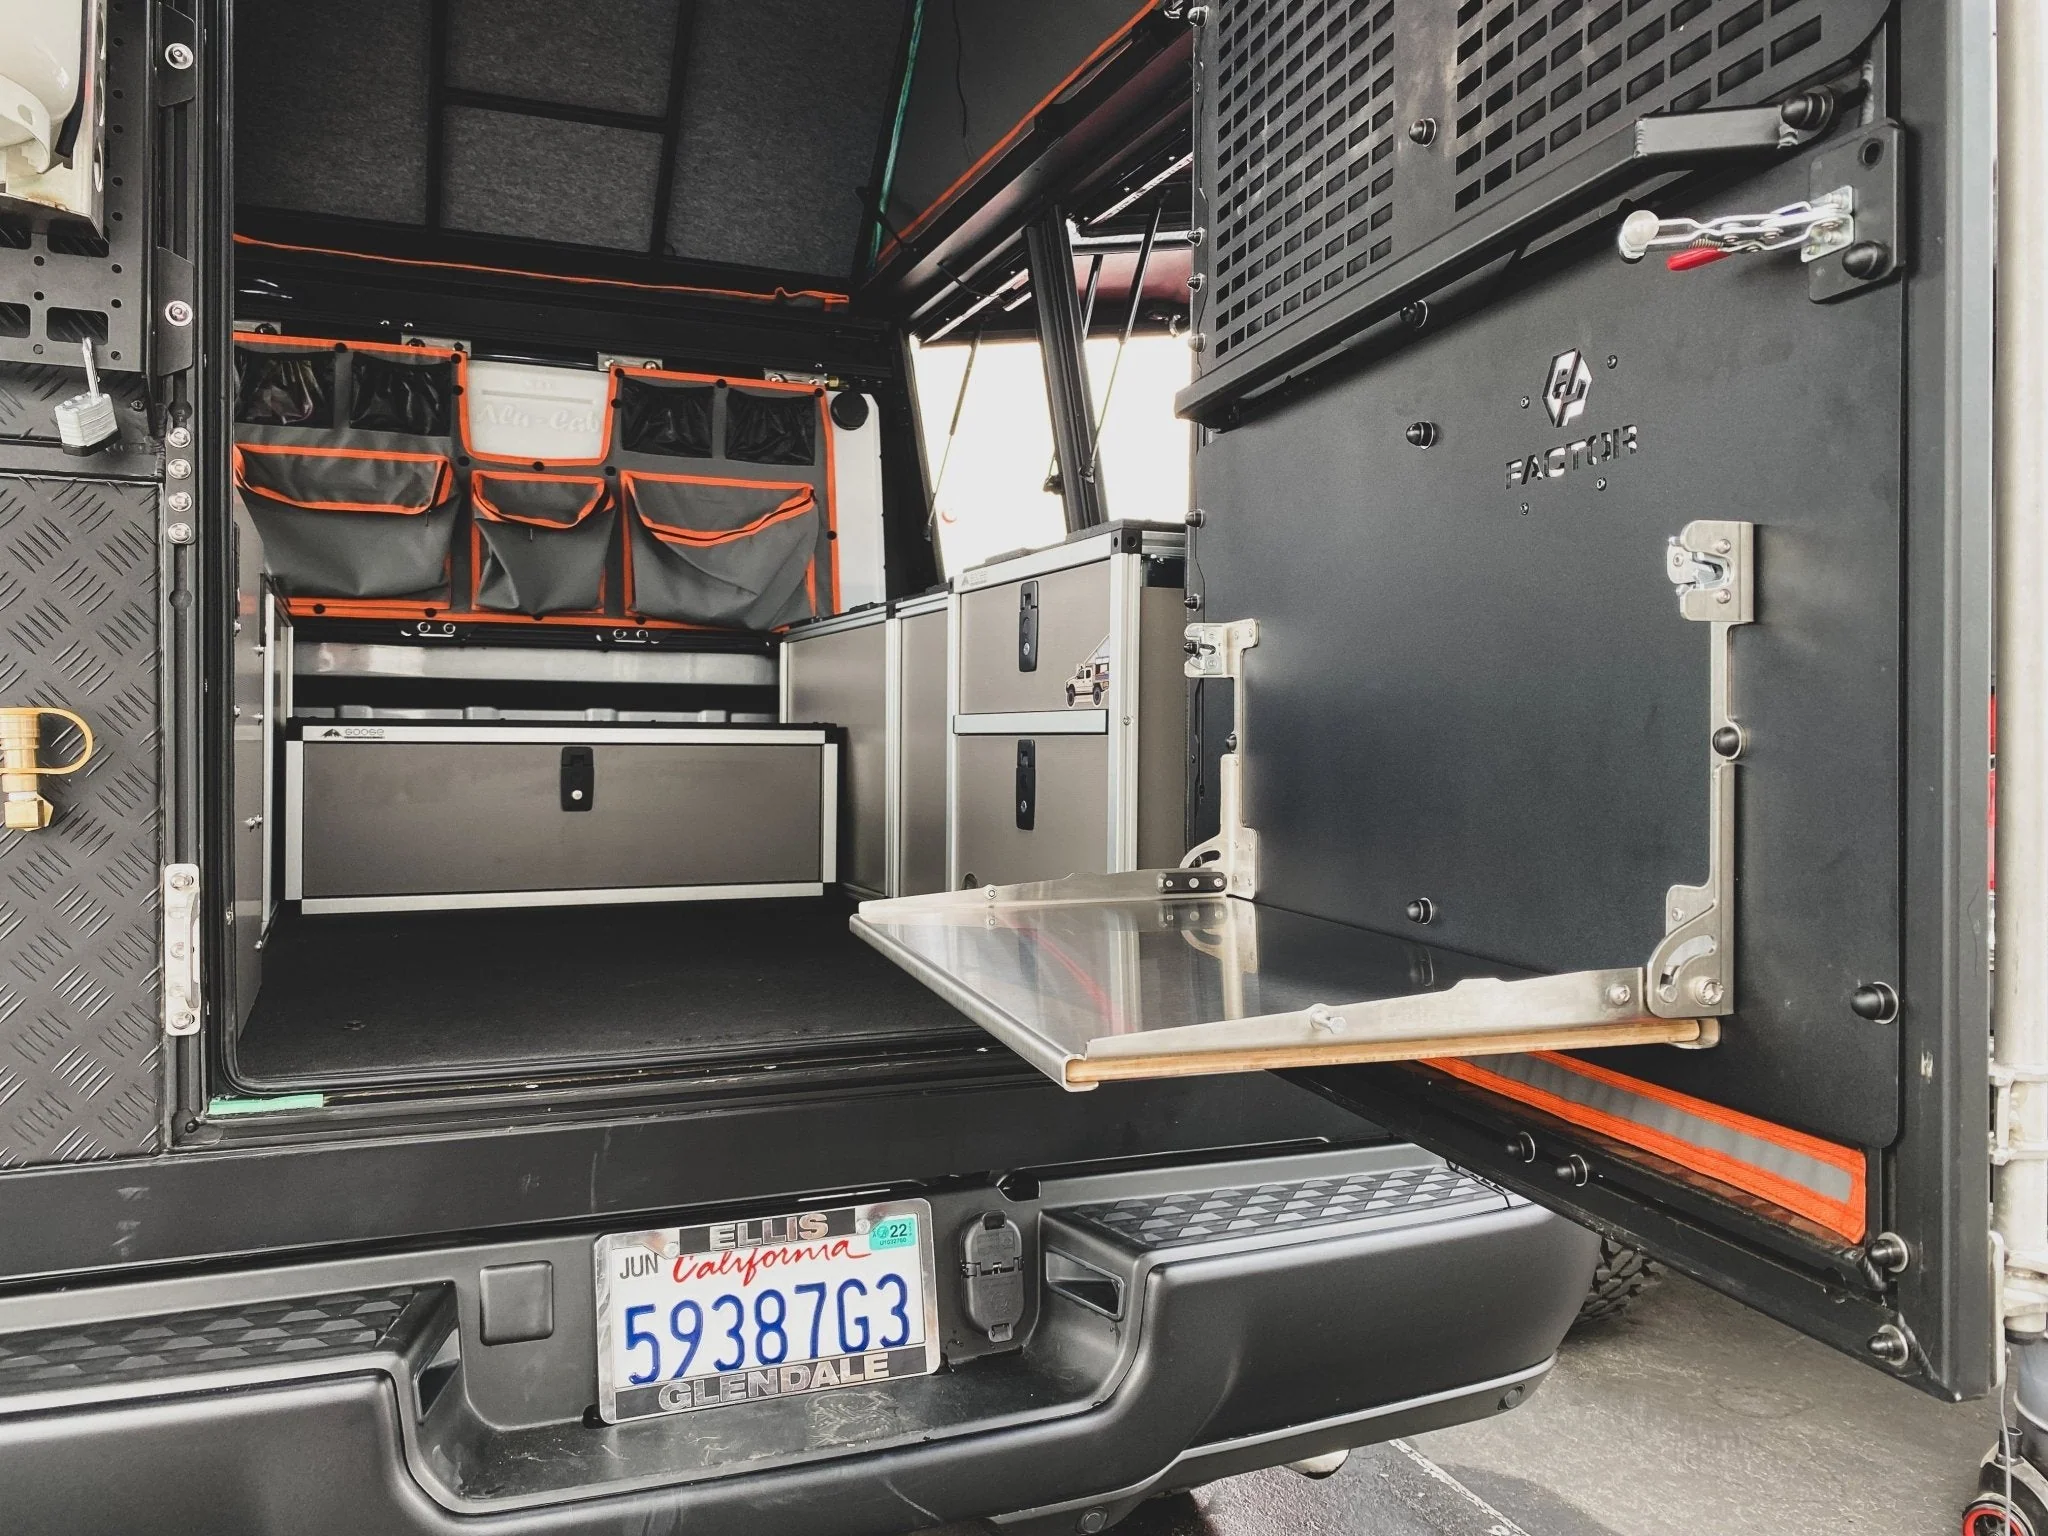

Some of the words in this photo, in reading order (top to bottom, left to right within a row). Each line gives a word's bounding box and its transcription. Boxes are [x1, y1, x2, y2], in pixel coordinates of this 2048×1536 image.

[1505, 424, 1638, 490] FACTOR
[708, 1212, 830, 1251] ELLIS
[889, 1223, 908, 1238] 22
[619, 1253, 660, 1280] JUN
[672, 1238, 872, 1287] California
[624, 1273, 911, 1385] 59387G3
[658, 1353, 890, 1411] GLENDALE
